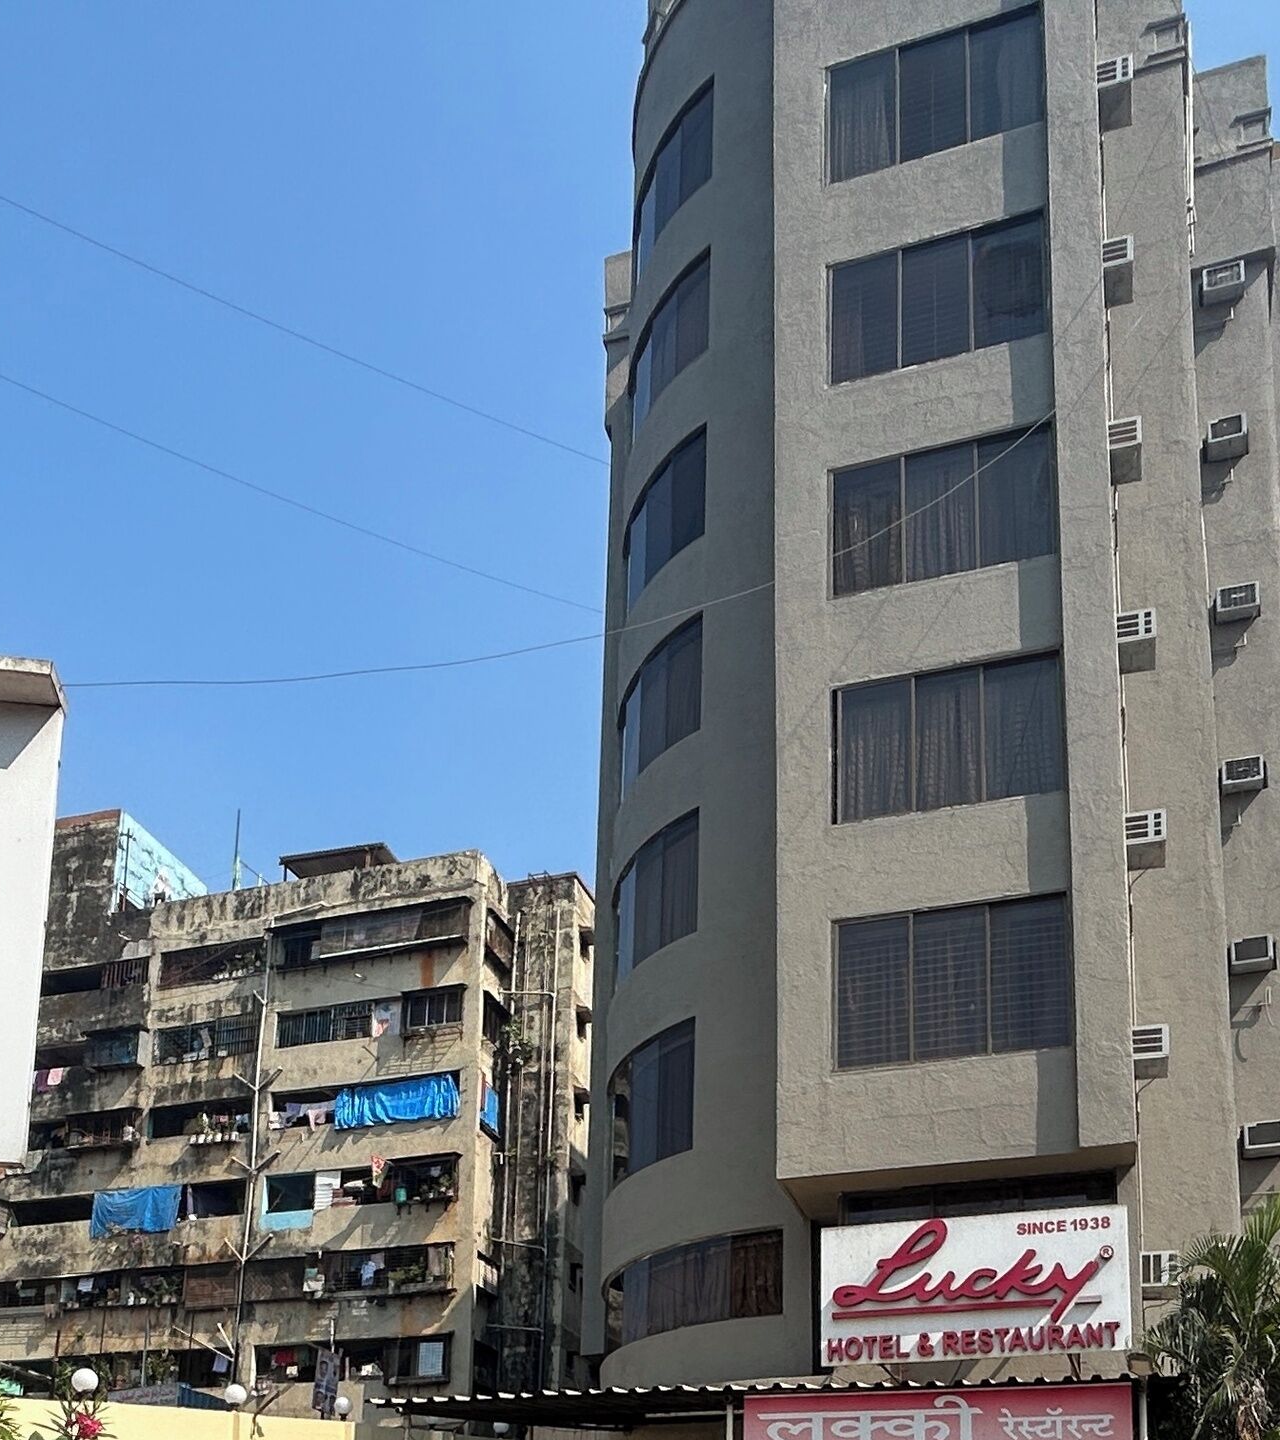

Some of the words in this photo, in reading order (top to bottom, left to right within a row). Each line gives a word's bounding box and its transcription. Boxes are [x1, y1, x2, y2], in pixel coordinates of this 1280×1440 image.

[1016, 1220, 1068, 1236] SINCE
[1070, 1216, 1111, 1231] 1938
[832, 1217, 1099, 1323] Lucky
[827, 1335, 910, 1362] HOTEL
[916, 1333, 935, 1357] &
[942, 1321, 1120, 1356] RESTAURANT
